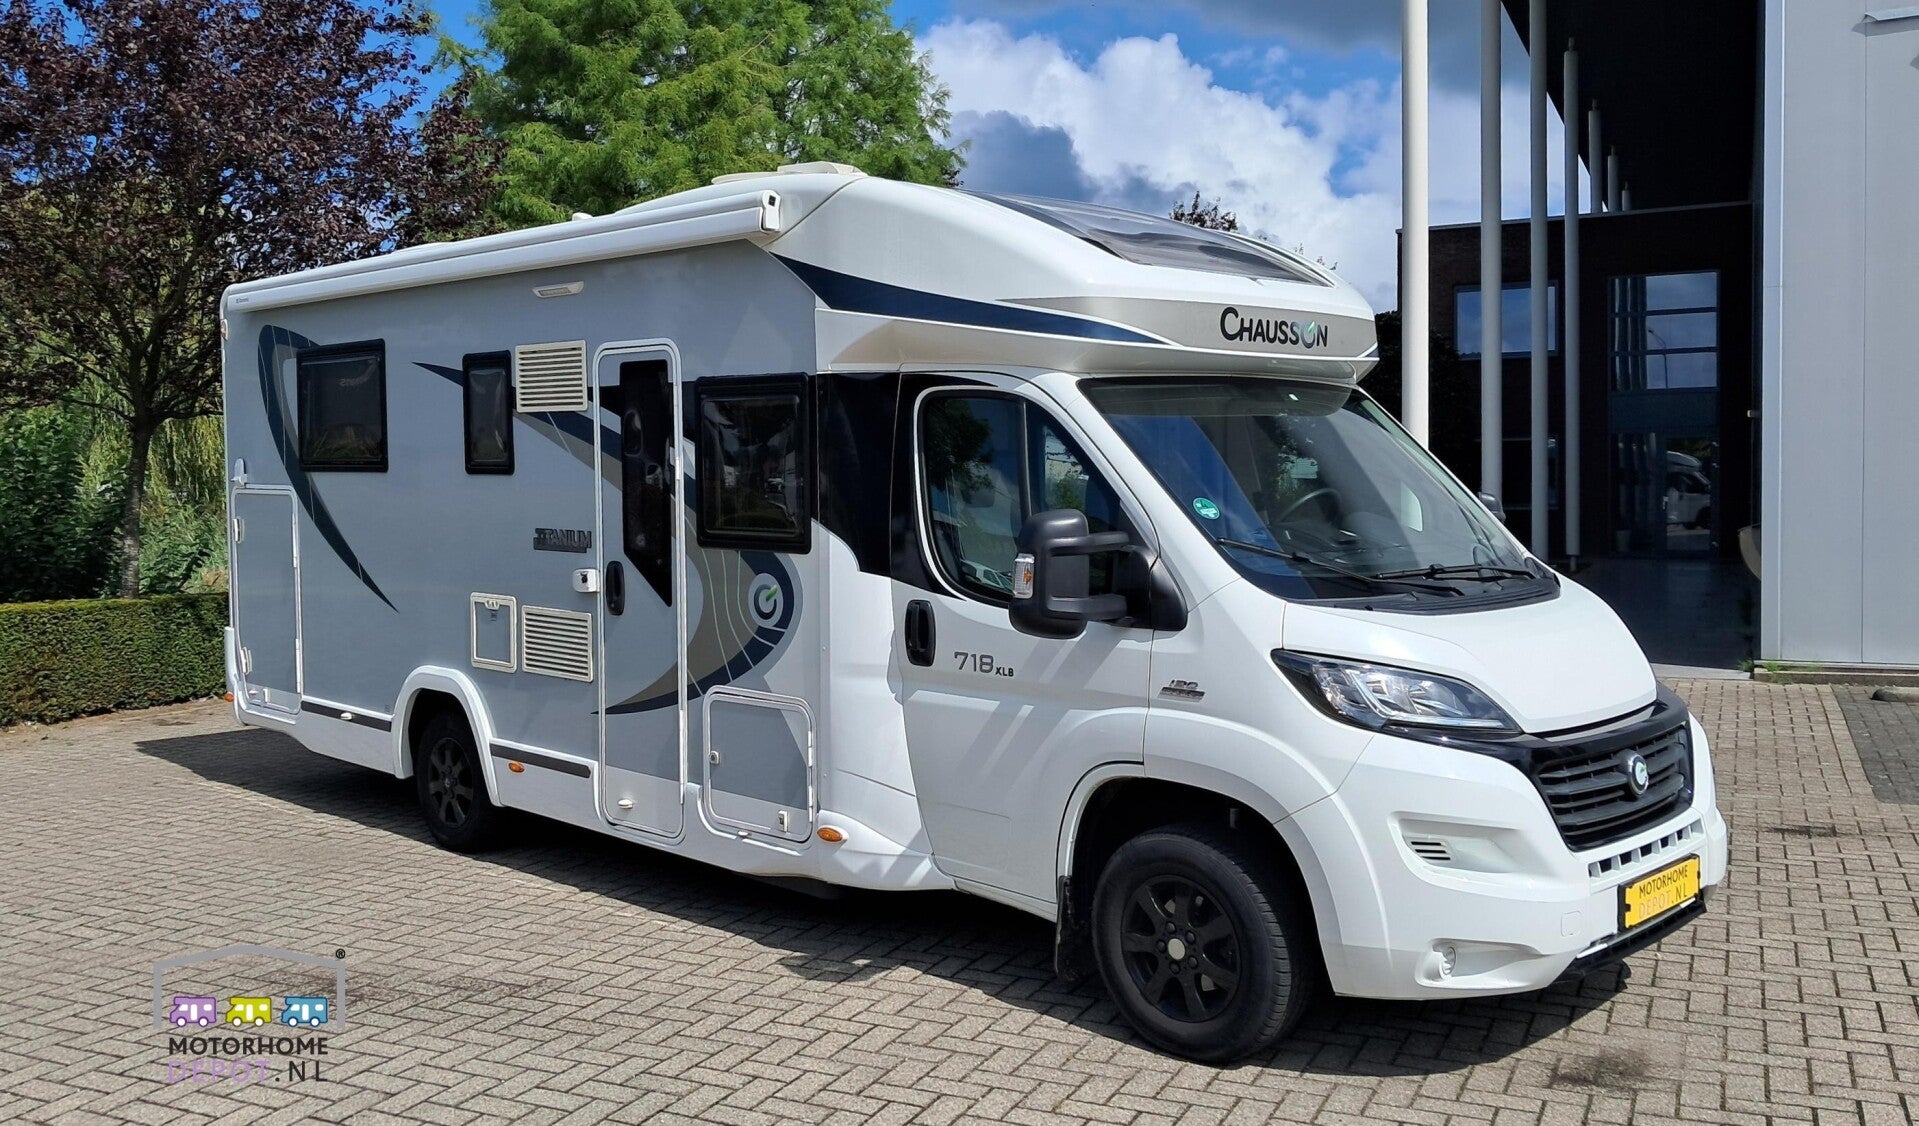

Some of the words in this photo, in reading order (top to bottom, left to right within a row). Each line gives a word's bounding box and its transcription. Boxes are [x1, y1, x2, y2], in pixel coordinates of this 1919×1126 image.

[1220, 306, 1328, 349] CHAUSSON
[533, 528, 592, 552] TITANIUM
[954, 651, 994, 674] 718
[995, 666, 1014, 677] XLB
[1639, 864, 1688, 899] MOTORHOME
[1639, 882, 1688, 919] DEPOT.NL
